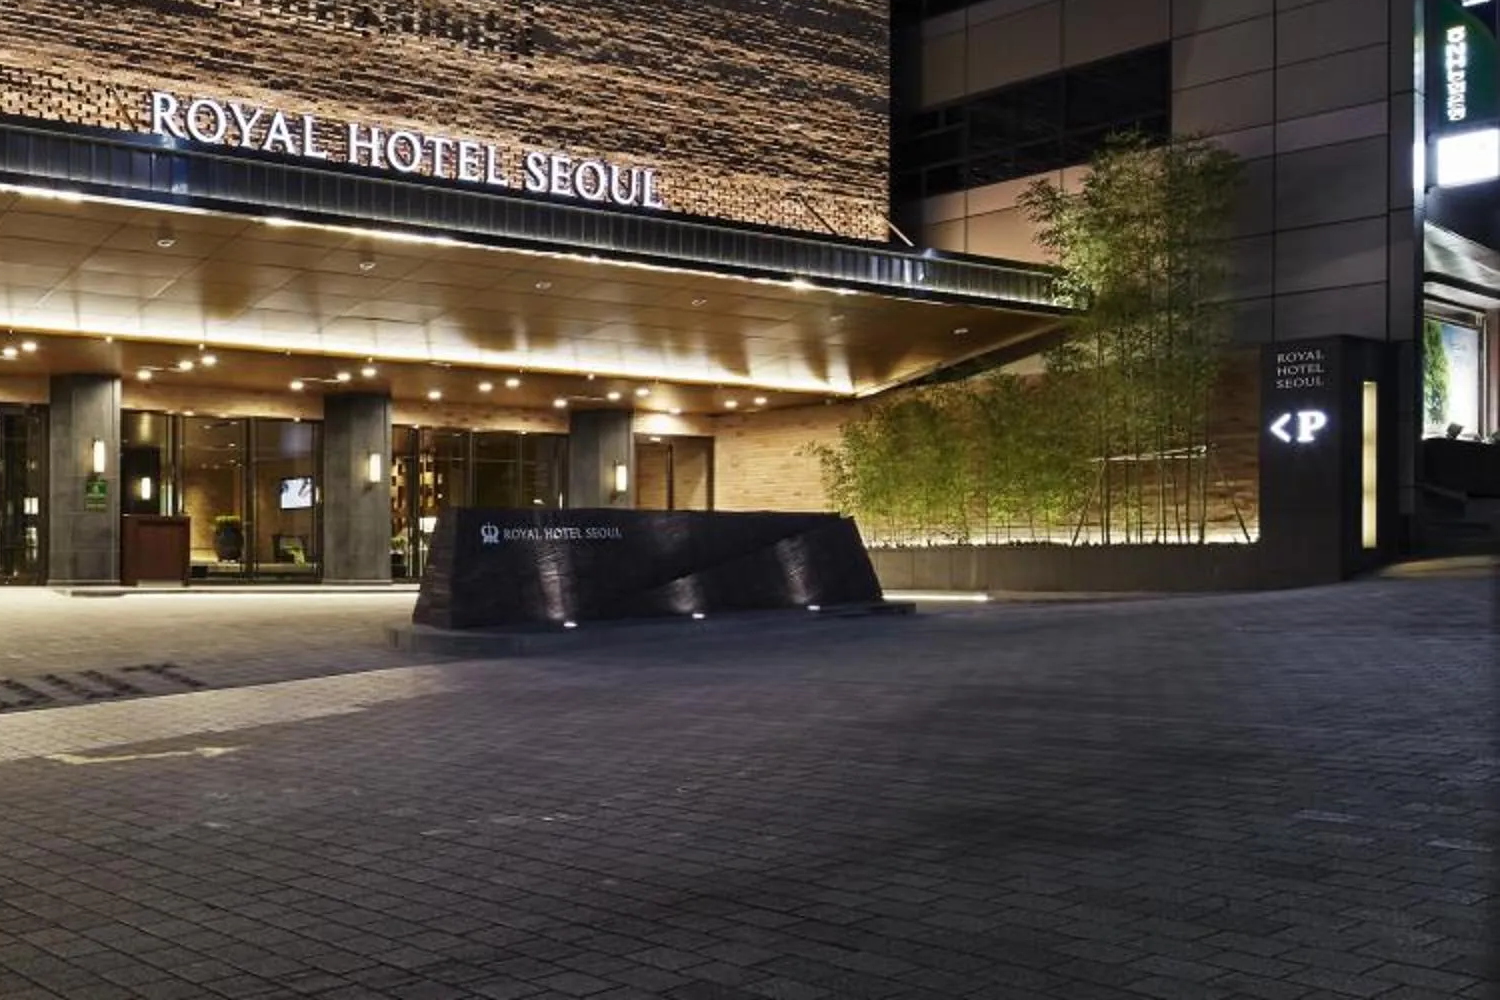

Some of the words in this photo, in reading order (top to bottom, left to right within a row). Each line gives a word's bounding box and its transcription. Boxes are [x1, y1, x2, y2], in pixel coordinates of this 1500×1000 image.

[151, 91, 328, 159] ROYAL
[348, 123, 508, 187] HOTEL
[525, 151, 663, 209] SEOUL
[1277, 350, 1324, 363] ROYAL
[1277, 364, 1324, 376] HOTEL
[1276, 377, 1324, 388] SEOUL
[1297, 410, 1326, 442] P
[503, 527, 542, 540] ROYAL
[544, 526, 582, 539] HOTEL
[585, 526, 622, 539] SEOUL
